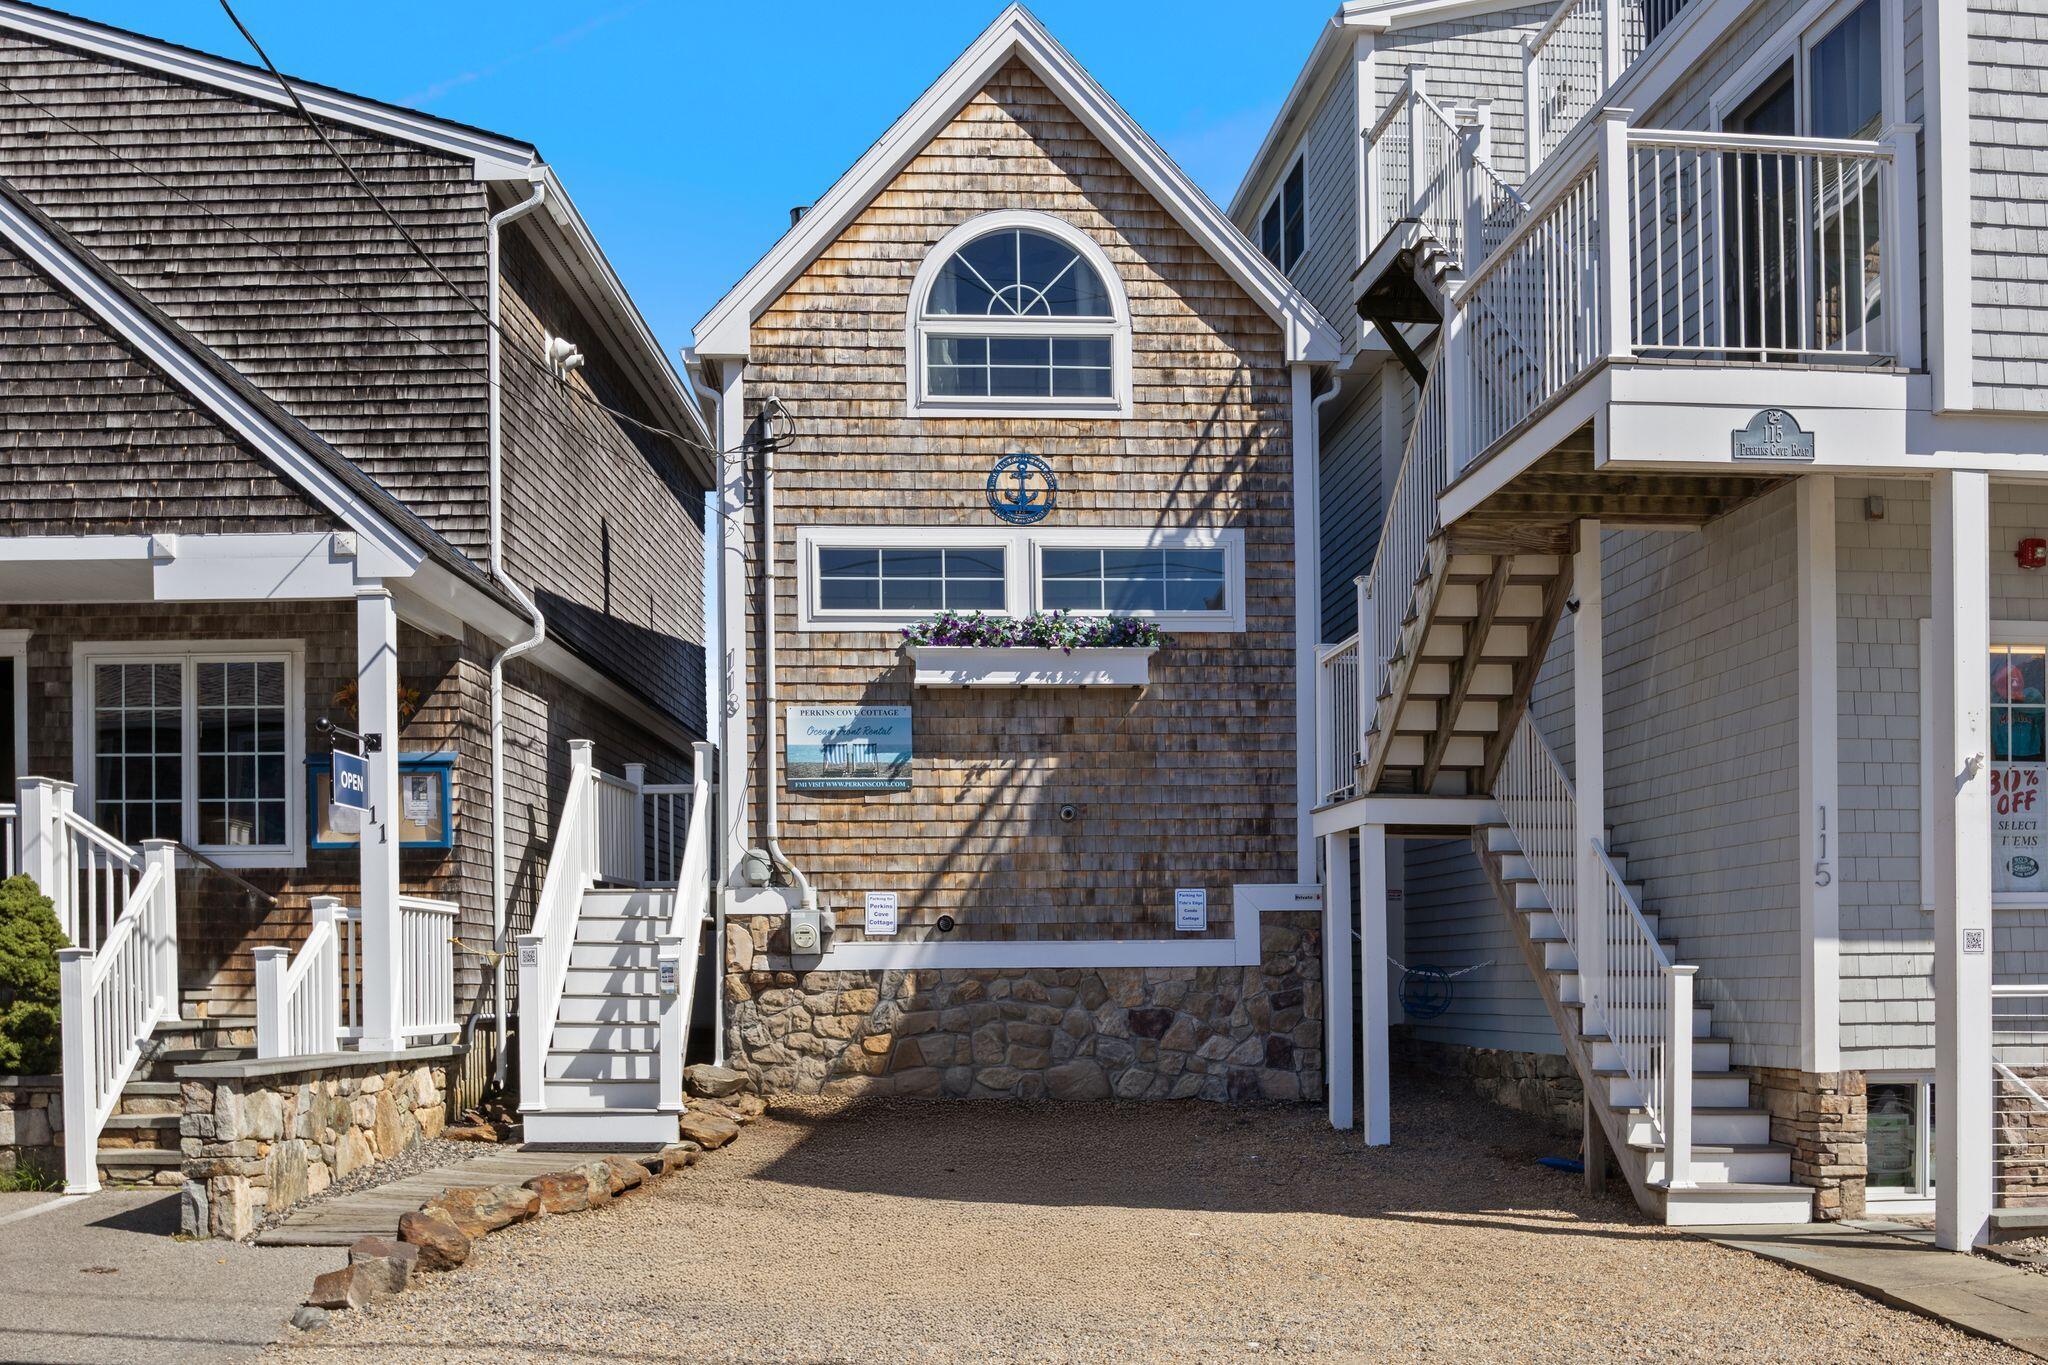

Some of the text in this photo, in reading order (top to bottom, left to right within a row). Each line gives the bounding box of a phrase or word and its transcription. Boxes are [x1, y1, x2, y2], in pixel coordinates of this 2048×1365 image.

[1763, 425, 1784, 444] 115
[800, 709, 899, 717] PERKINS COVE COTTAGE
[806, 725, 893, 736] Ocean Front Rental
[340, 770, 364, 792] OPEN
[1997, 789, 2037, 815] OFF
[1998, 820, 2038, 831] SELECT
[1815, 805, 1832, 887] 115
[2002, 836, 2039, 847] IEMS
